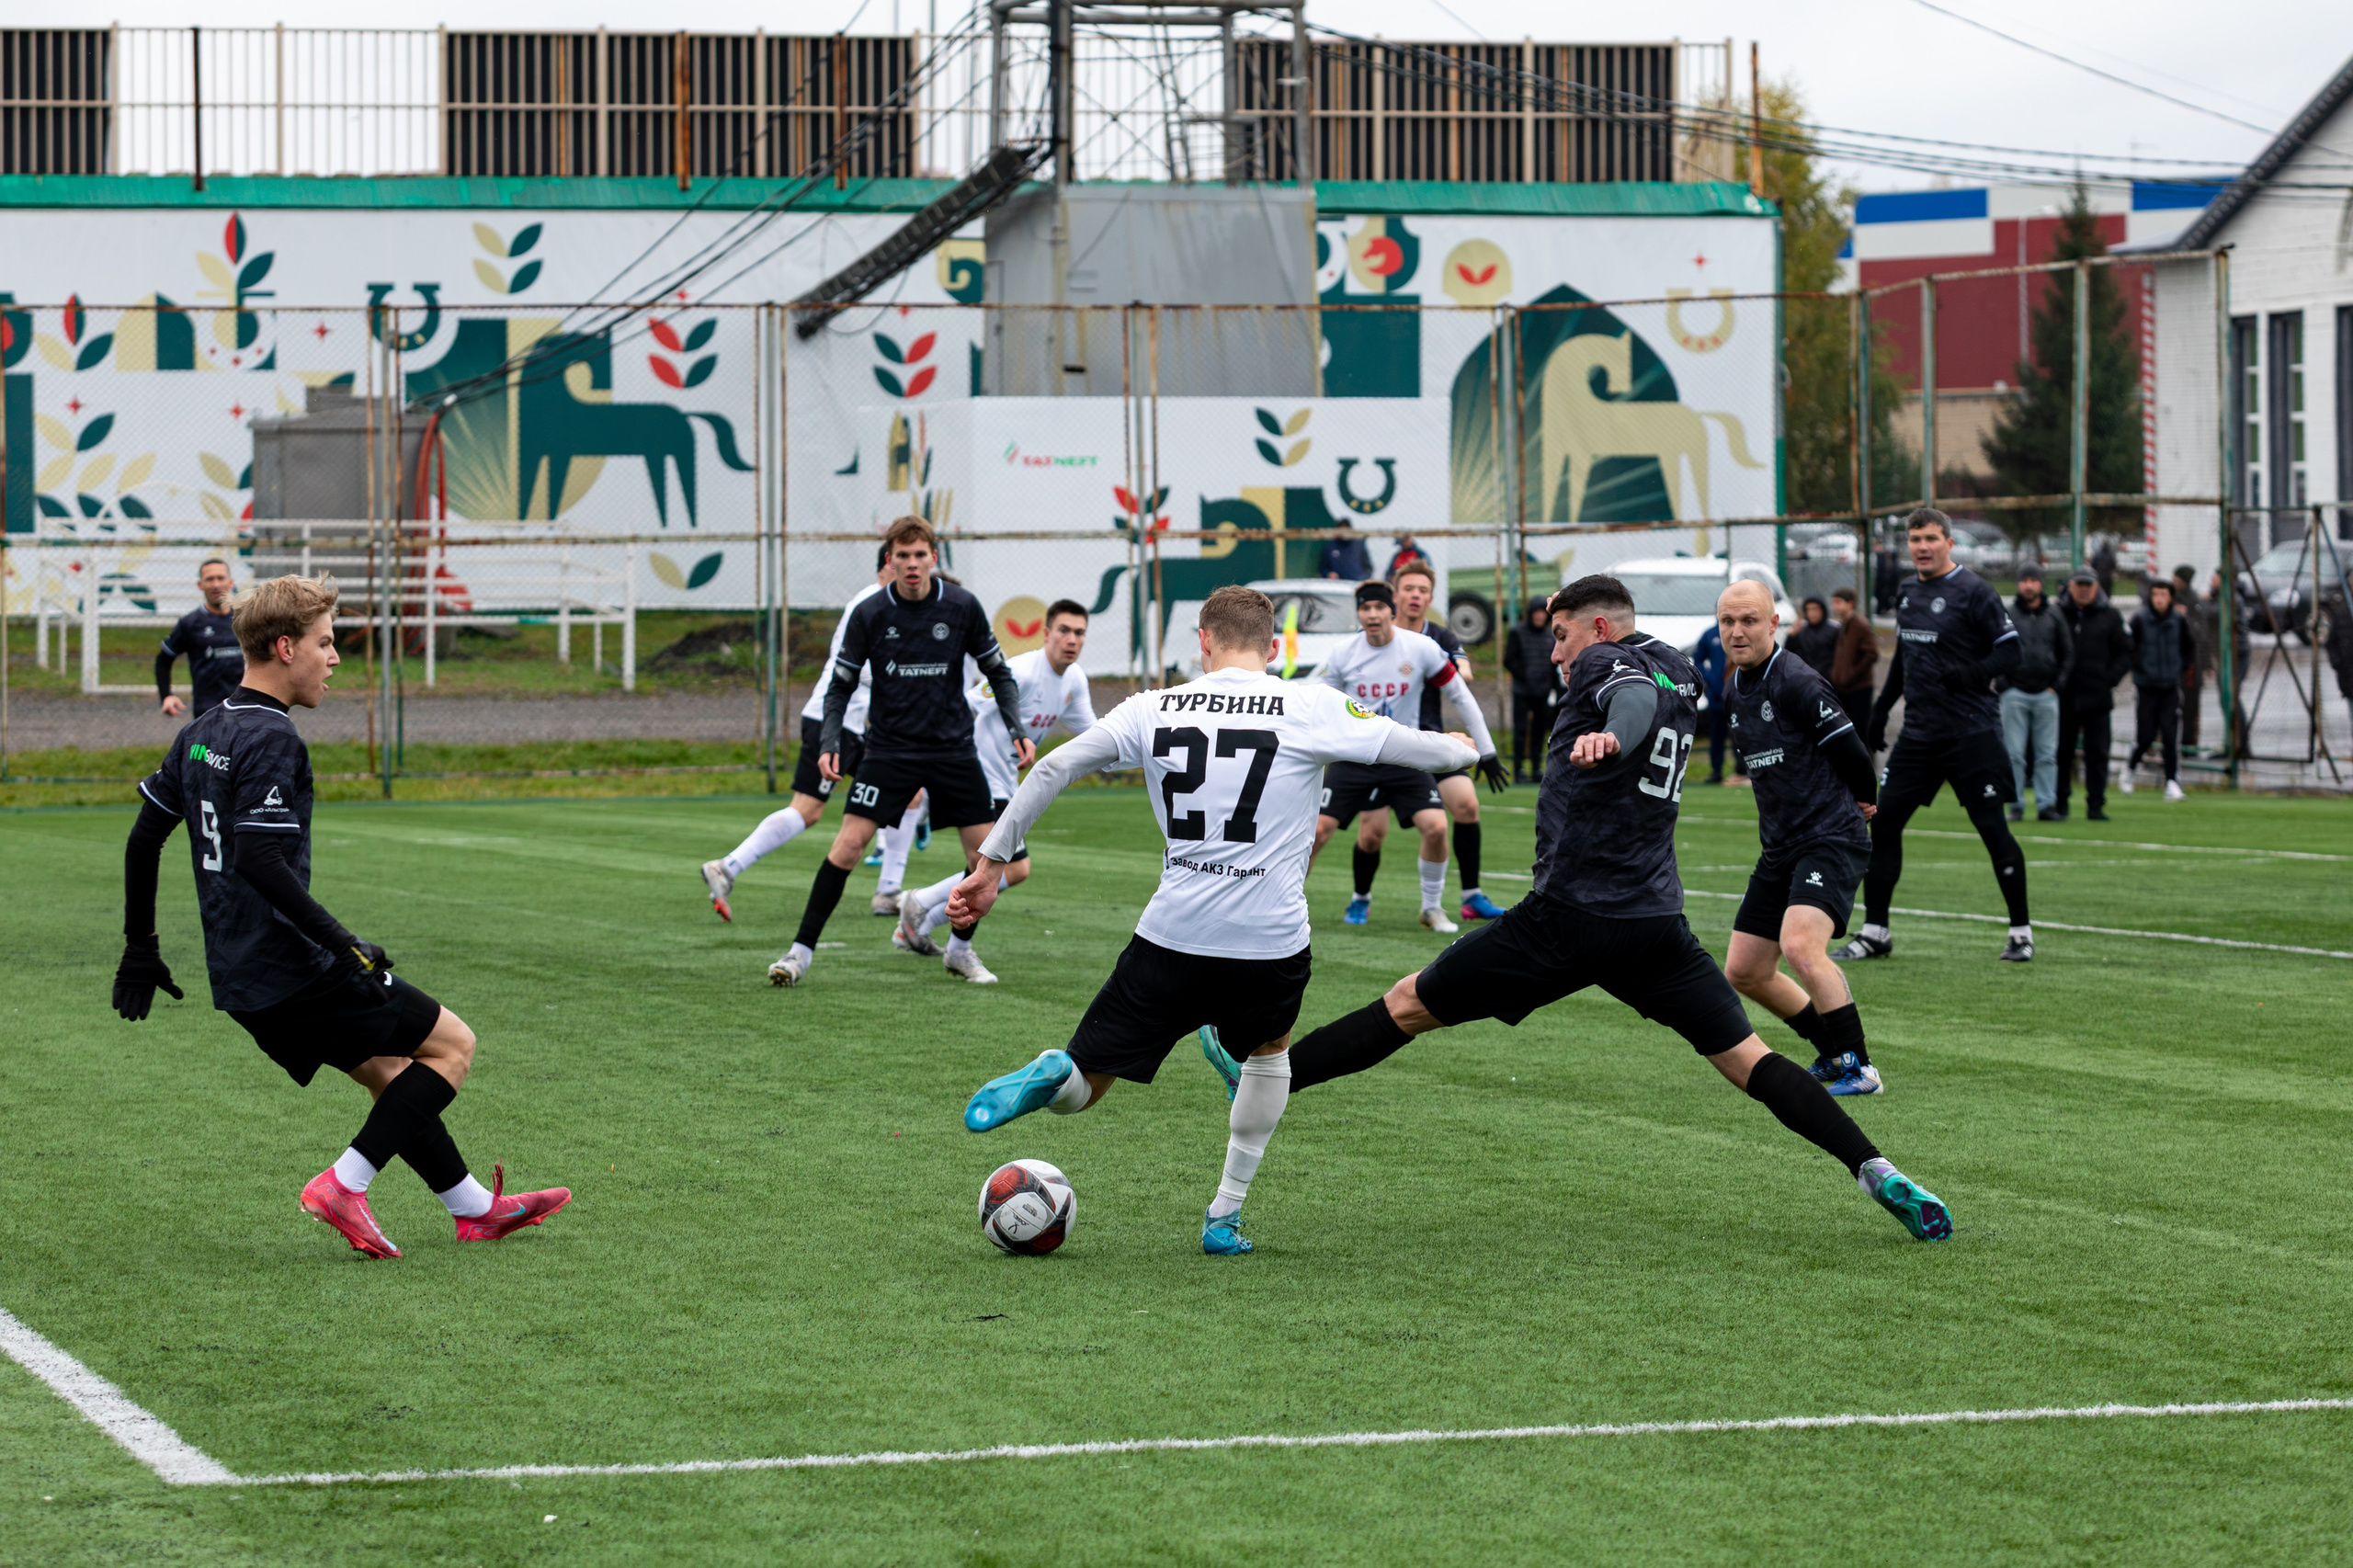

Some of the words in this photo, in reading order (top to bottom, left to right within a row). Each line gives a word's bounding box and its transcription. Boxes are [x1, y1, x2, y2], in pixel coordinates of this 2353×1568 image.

[898, 667, 949, 676] TATNEFT
[1358, 683, 1409, 698] СССР
[1160, 693, 1284, 716] ТУРБИНА
[1638, 726, 1694, 803] 92
[1746, 753, 1784, 770] TATNEFT
[850, 782, 880, 808] 30
[1152, 726, 1280, 844] 27
[200, 800, 222, 872] 9
[1170, 857, 1199, 873] Завод
[1200, 862, 1224, 876] АКЗ
